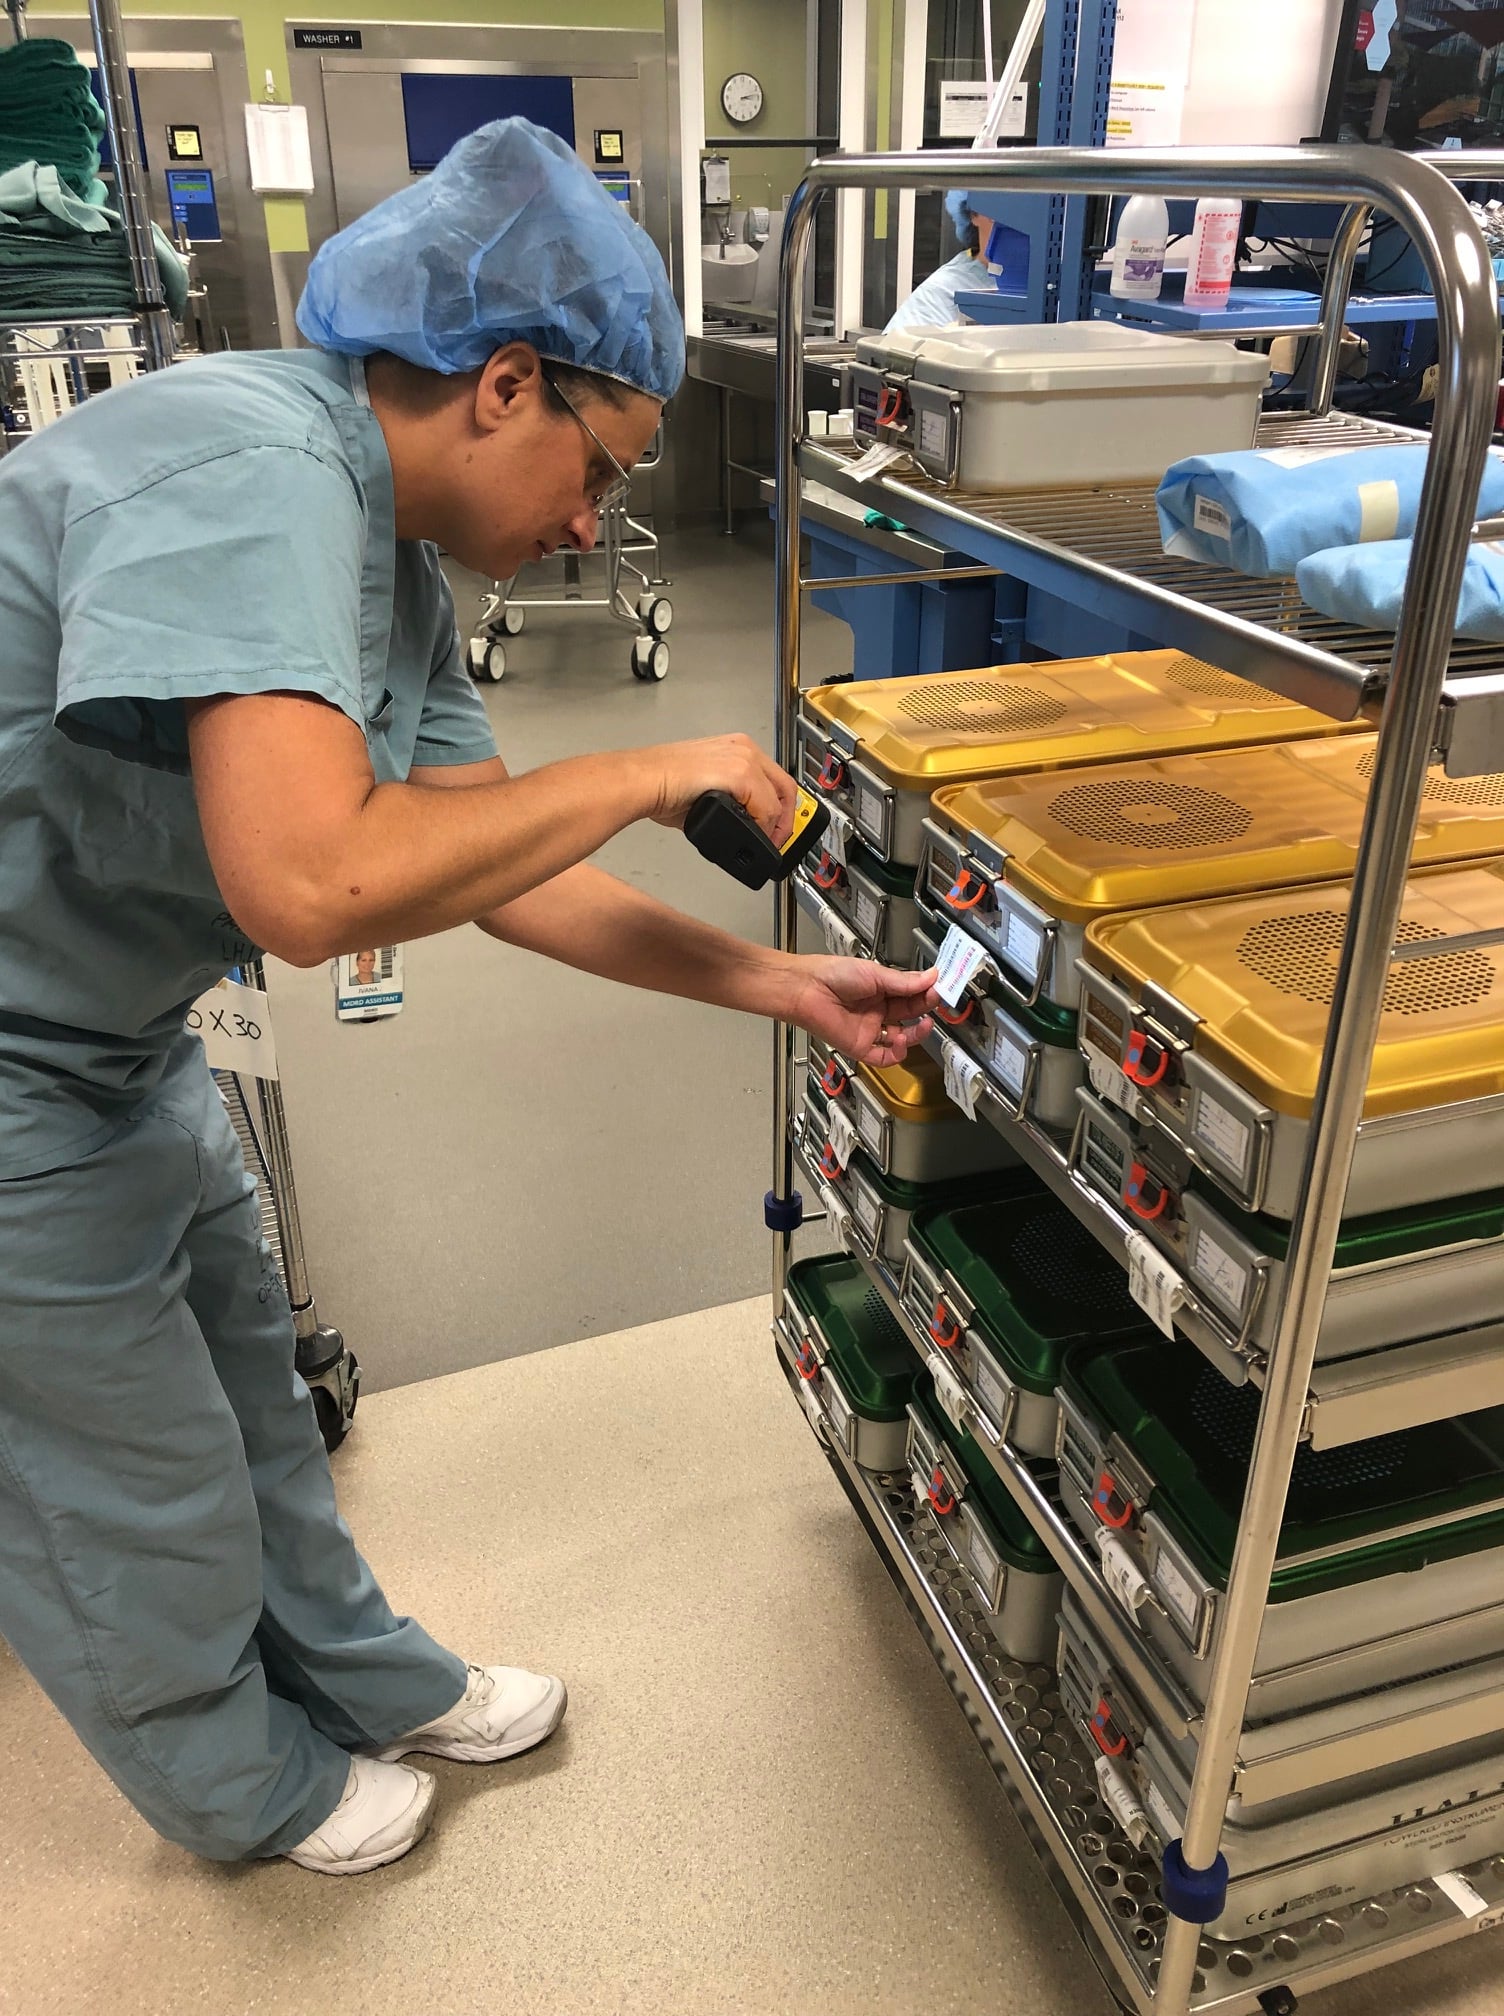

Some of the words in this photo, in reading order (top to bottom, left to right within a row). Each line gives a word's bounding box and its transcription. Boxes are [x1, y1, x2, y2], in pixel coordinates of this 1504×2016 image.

[302, 34, 340, 44] WASHER
[365, 995, 399, 1005] ASSISTANT
[233, 1013, 262, 1040] 30
